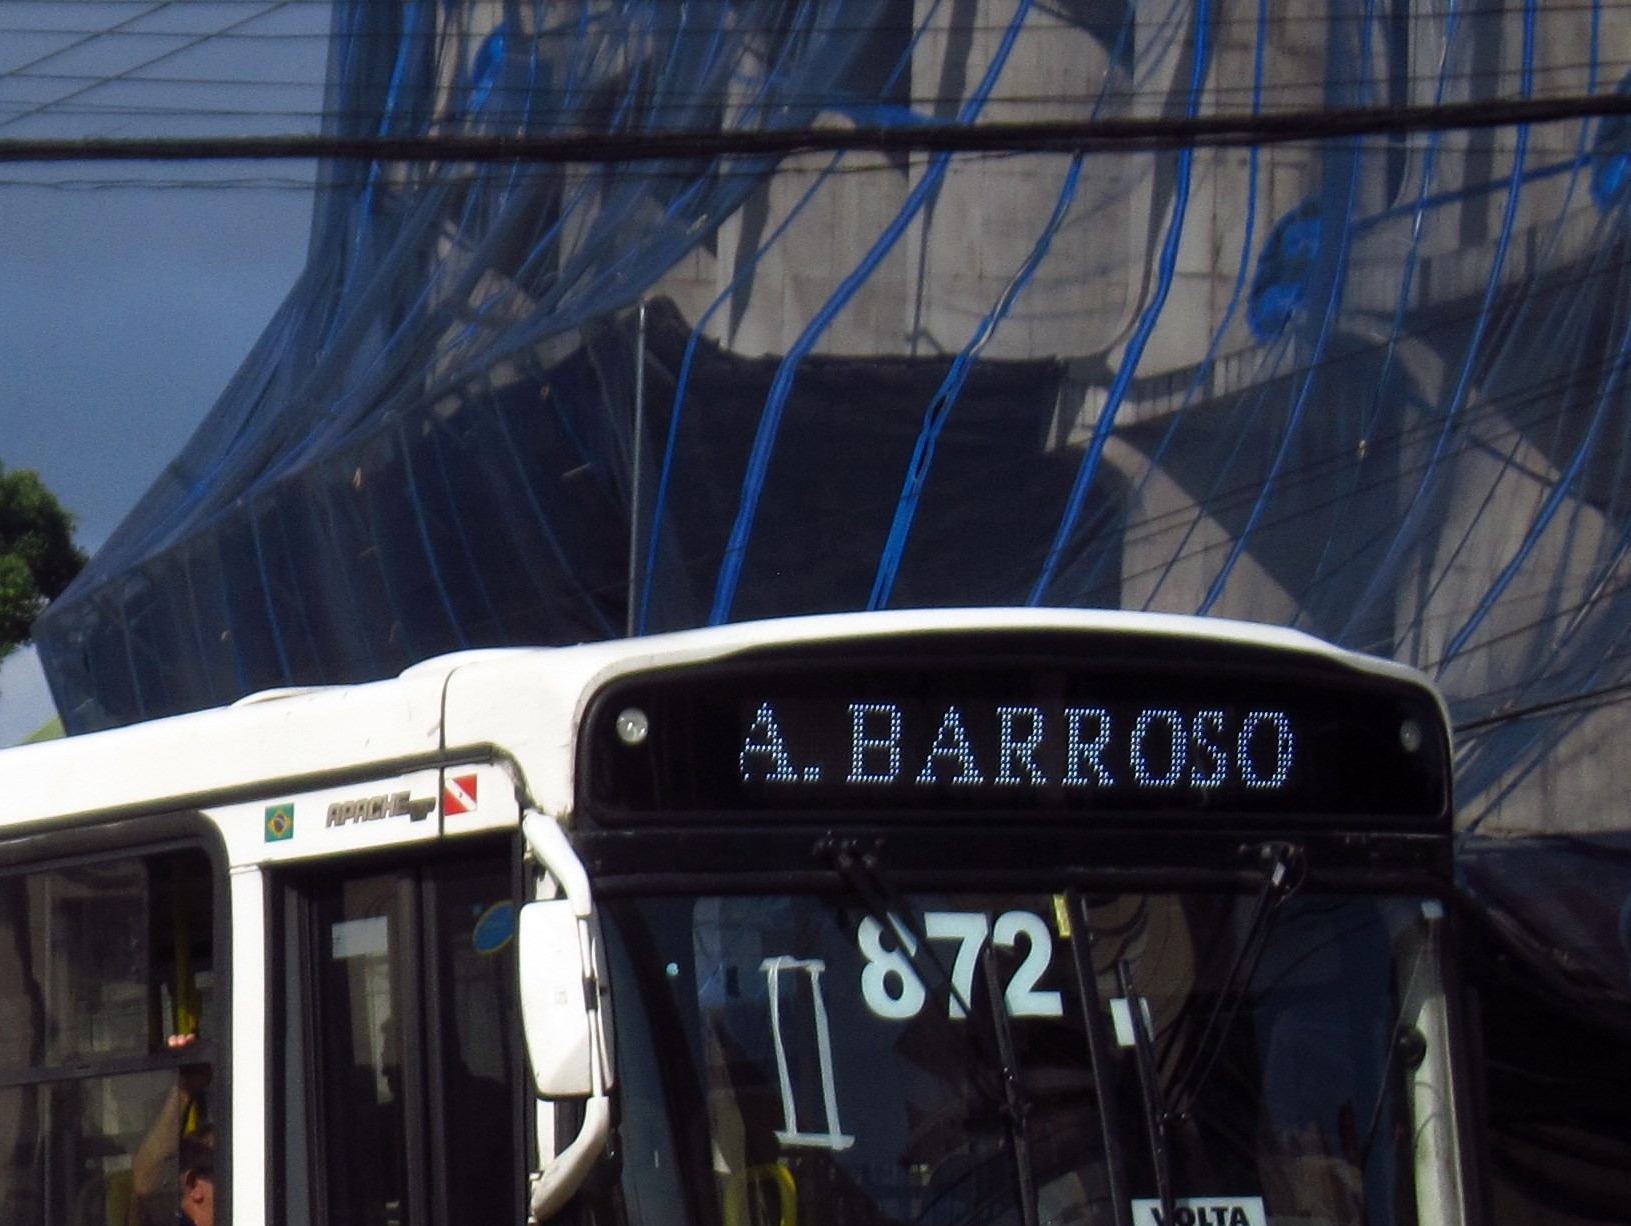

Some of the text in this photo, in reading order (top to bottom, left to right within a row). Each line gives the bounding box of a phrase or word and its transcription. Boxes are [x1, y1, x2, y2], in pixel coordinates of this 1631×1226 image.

[739, 701, 1295, 788] A. BARROSO
[856, 910, 1064, 1019] 872
